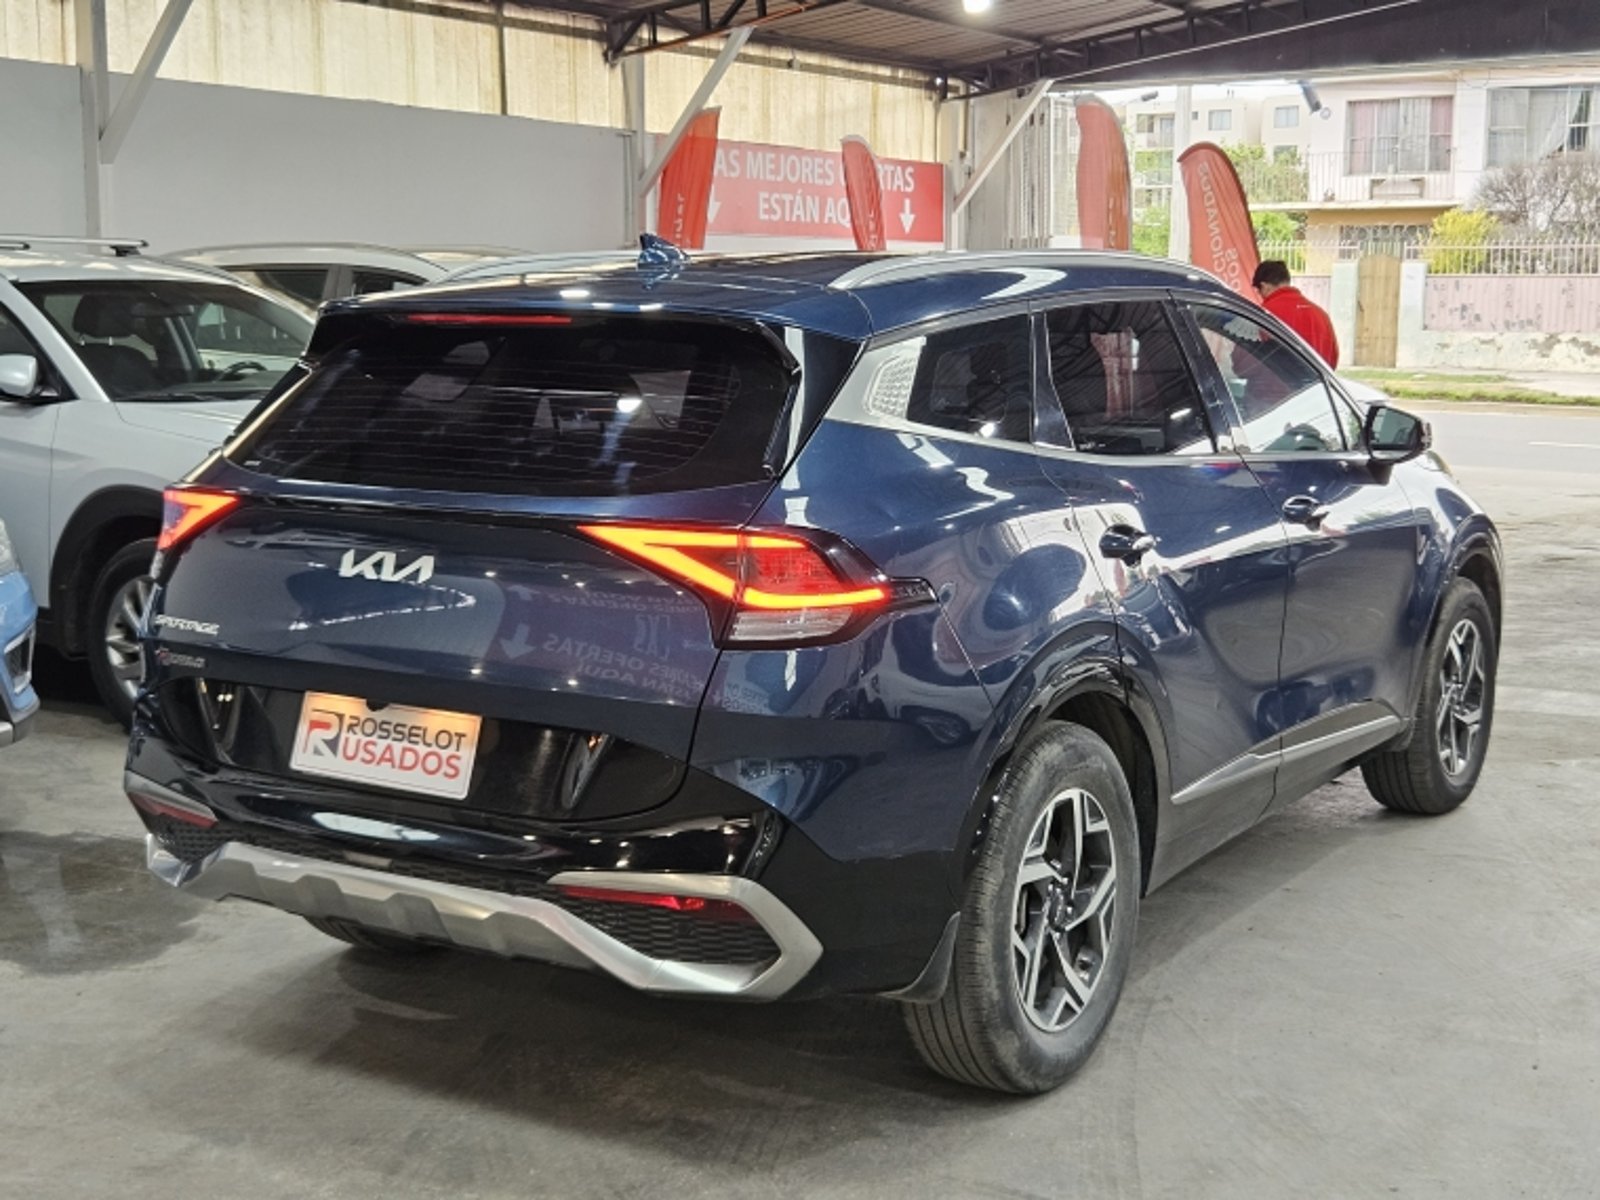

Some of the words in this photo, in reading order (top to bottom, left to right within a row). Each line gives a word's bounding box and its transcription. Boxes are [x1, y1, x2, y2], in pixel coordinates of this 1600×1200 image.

[713, 148, 740, 178] AS
[746, 151, 834, 187] MEJORES
[758, 188, 820, 222] ESTÁN
[824, 197, 851, 228] AQ
[338, 549, 435, 583] KIA
[346, 715, 467, 752] ROSSELOT
[341, 737, 462, 780] USADOS
